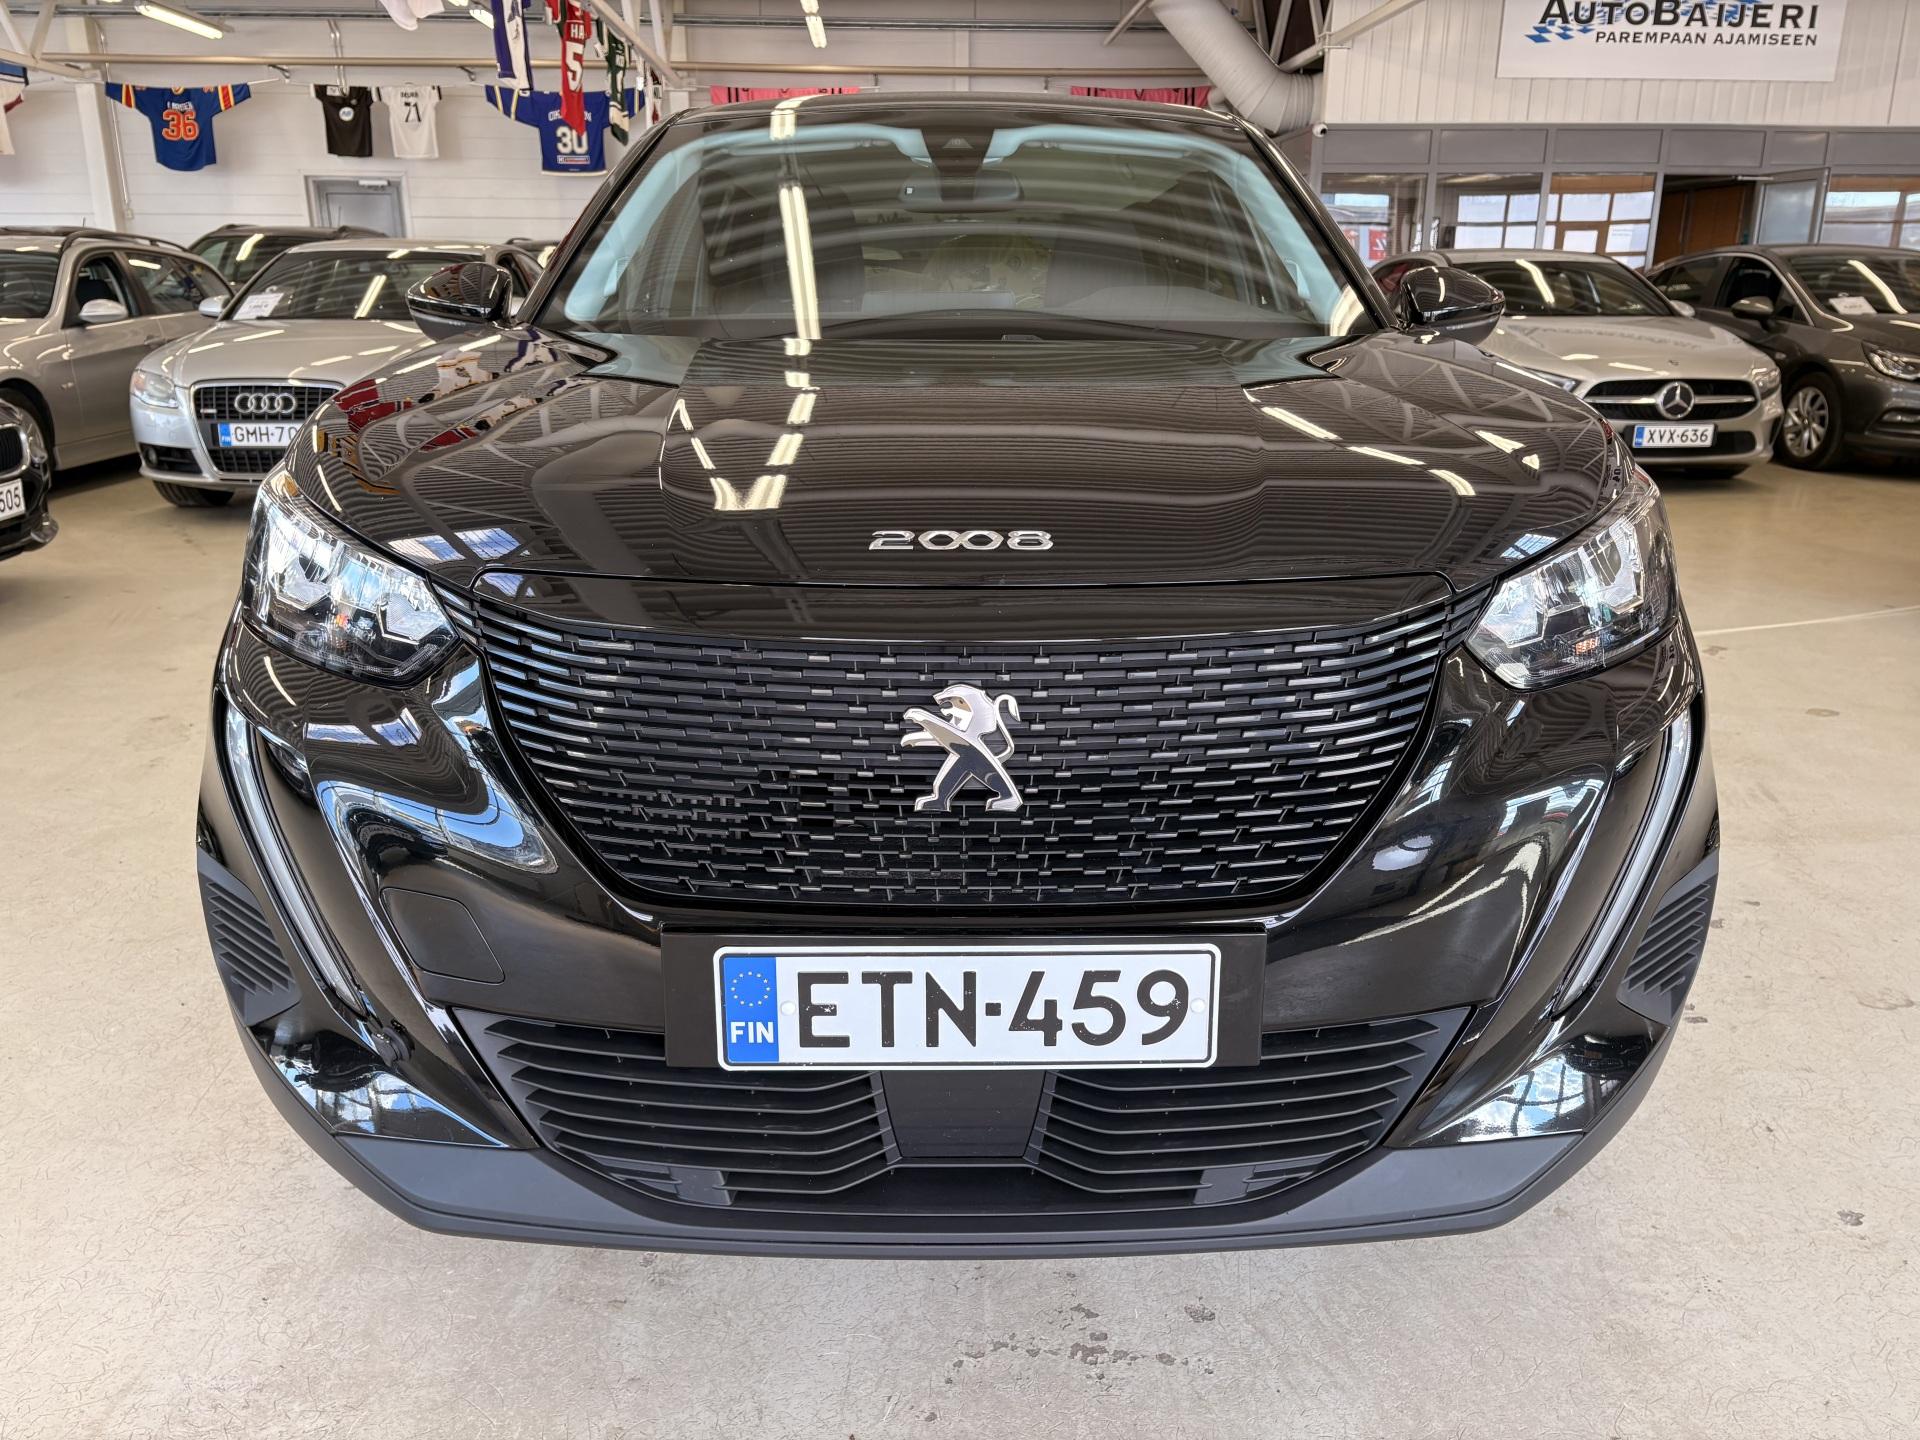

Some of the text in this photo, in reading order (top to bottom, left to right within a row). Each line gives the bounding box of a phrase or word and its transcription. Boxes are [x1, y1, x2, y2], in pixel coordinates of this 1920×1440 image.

[1595, 31, 1818, 47] PAREMPAAN AJAMISEEN
[403, 101, 422, 123] 71
[162, 108, 200, 141] 36
[1647, 428, 1709, 444] XVX-636
[868, 530, 1054, 551] 2008
[729, 969, 1191, 1048] FIN ETN-459
